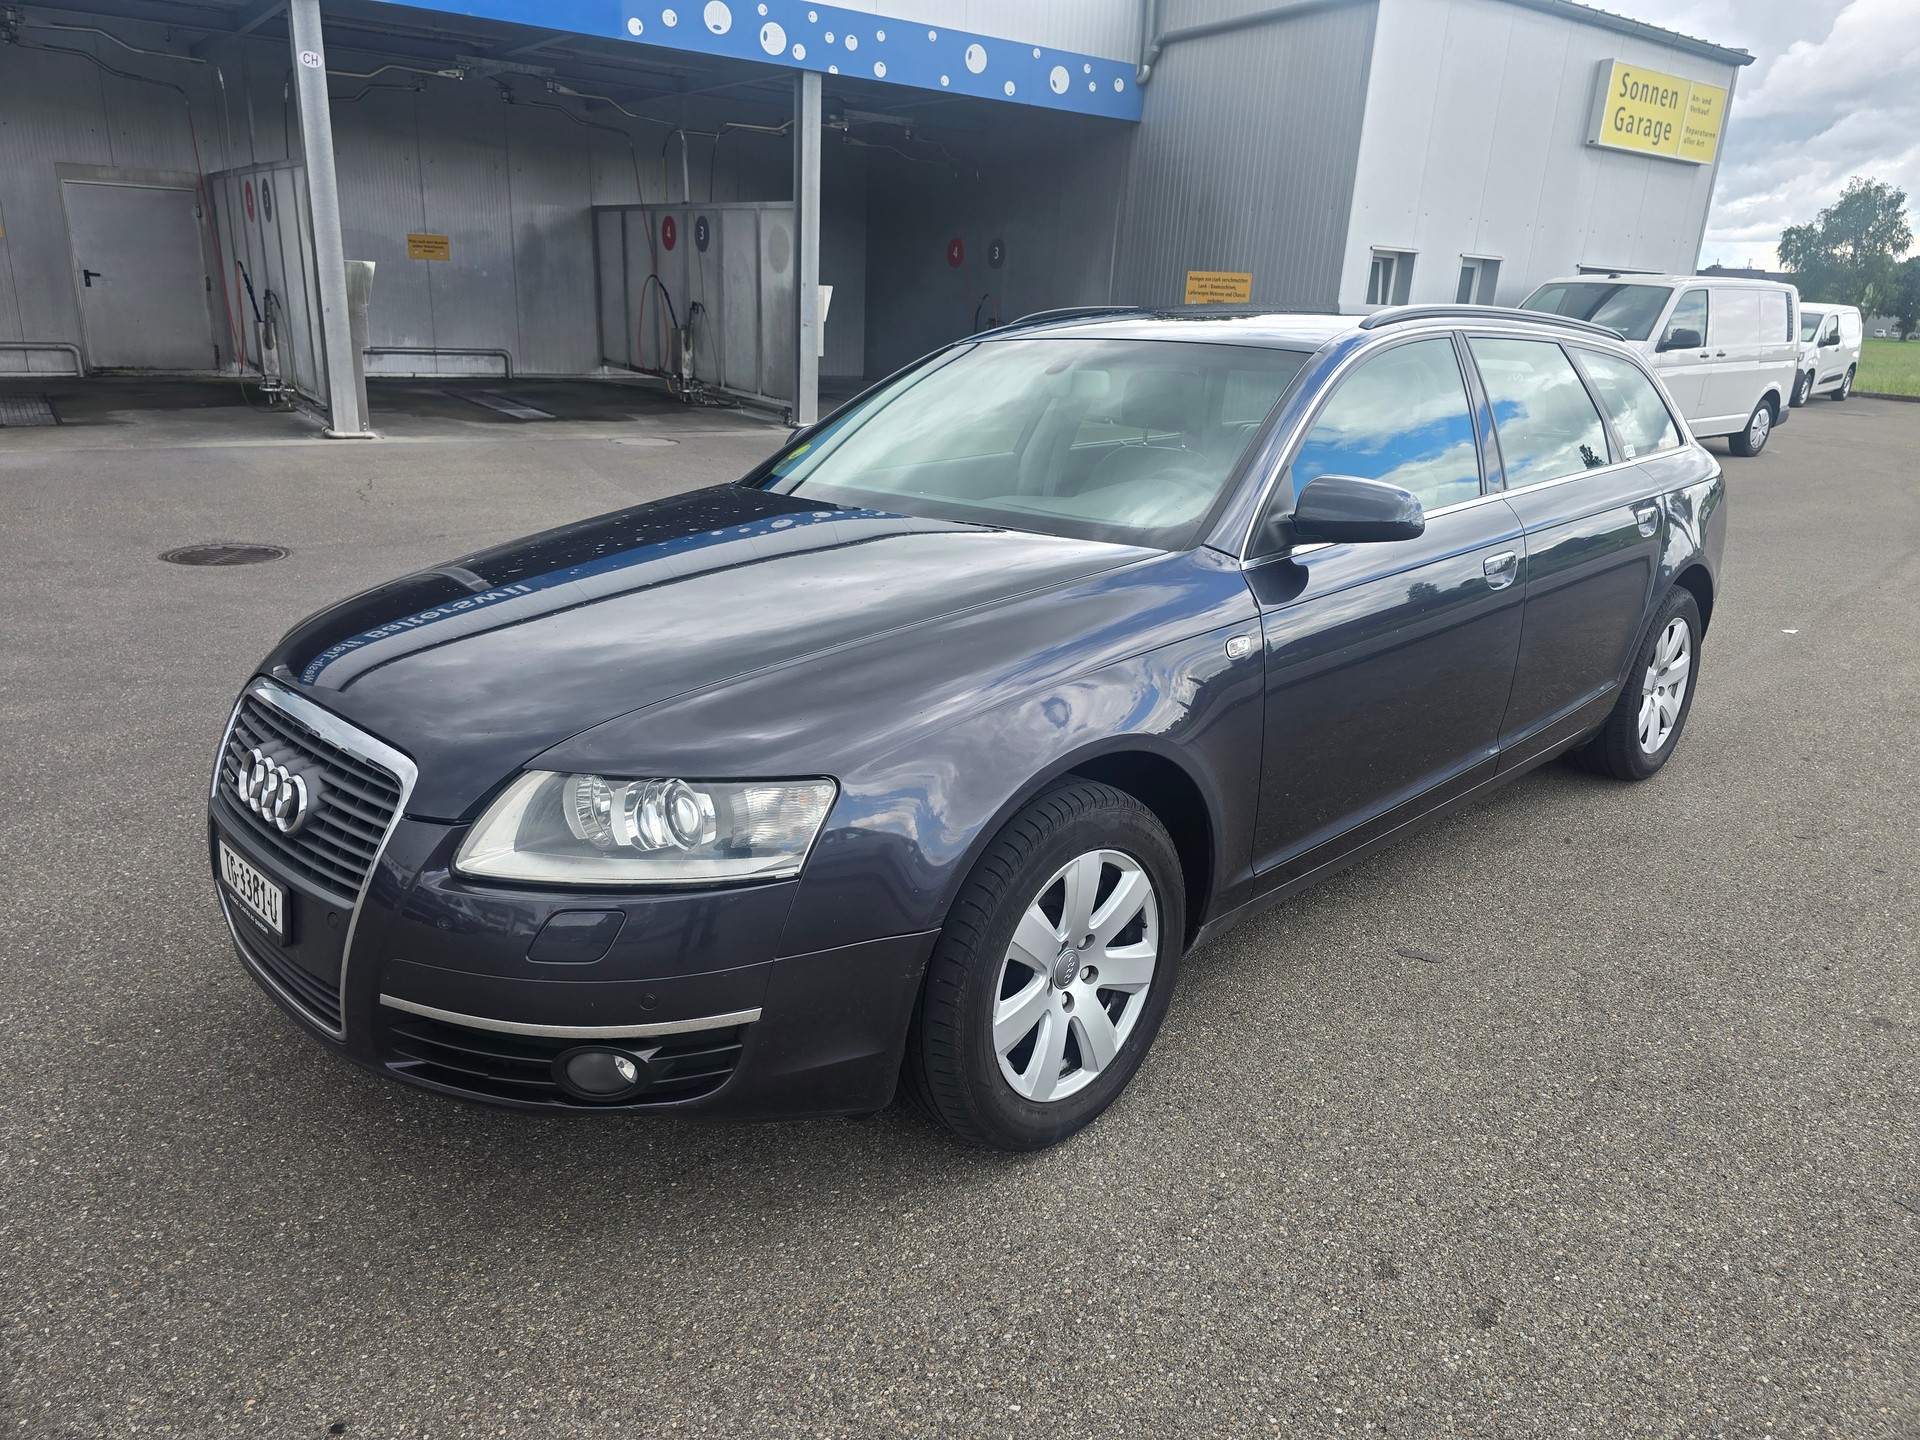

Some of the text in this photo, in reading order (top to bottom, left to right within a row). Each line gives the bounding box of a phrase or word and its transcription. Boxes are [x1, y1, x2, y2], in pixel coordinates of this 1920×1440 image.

[302, 52, 319, 66] CH
[1619, 72, 1679, 110] Sonnen
[1702, 98, 1713, 106] und
[1690, 105, 1710, 116] Verkauf
[1614, 106, 1672, 146] Garage
[1686, 126, 1716, 139] Reparaturen
[1683, 137, 1705, 148] aller Art
